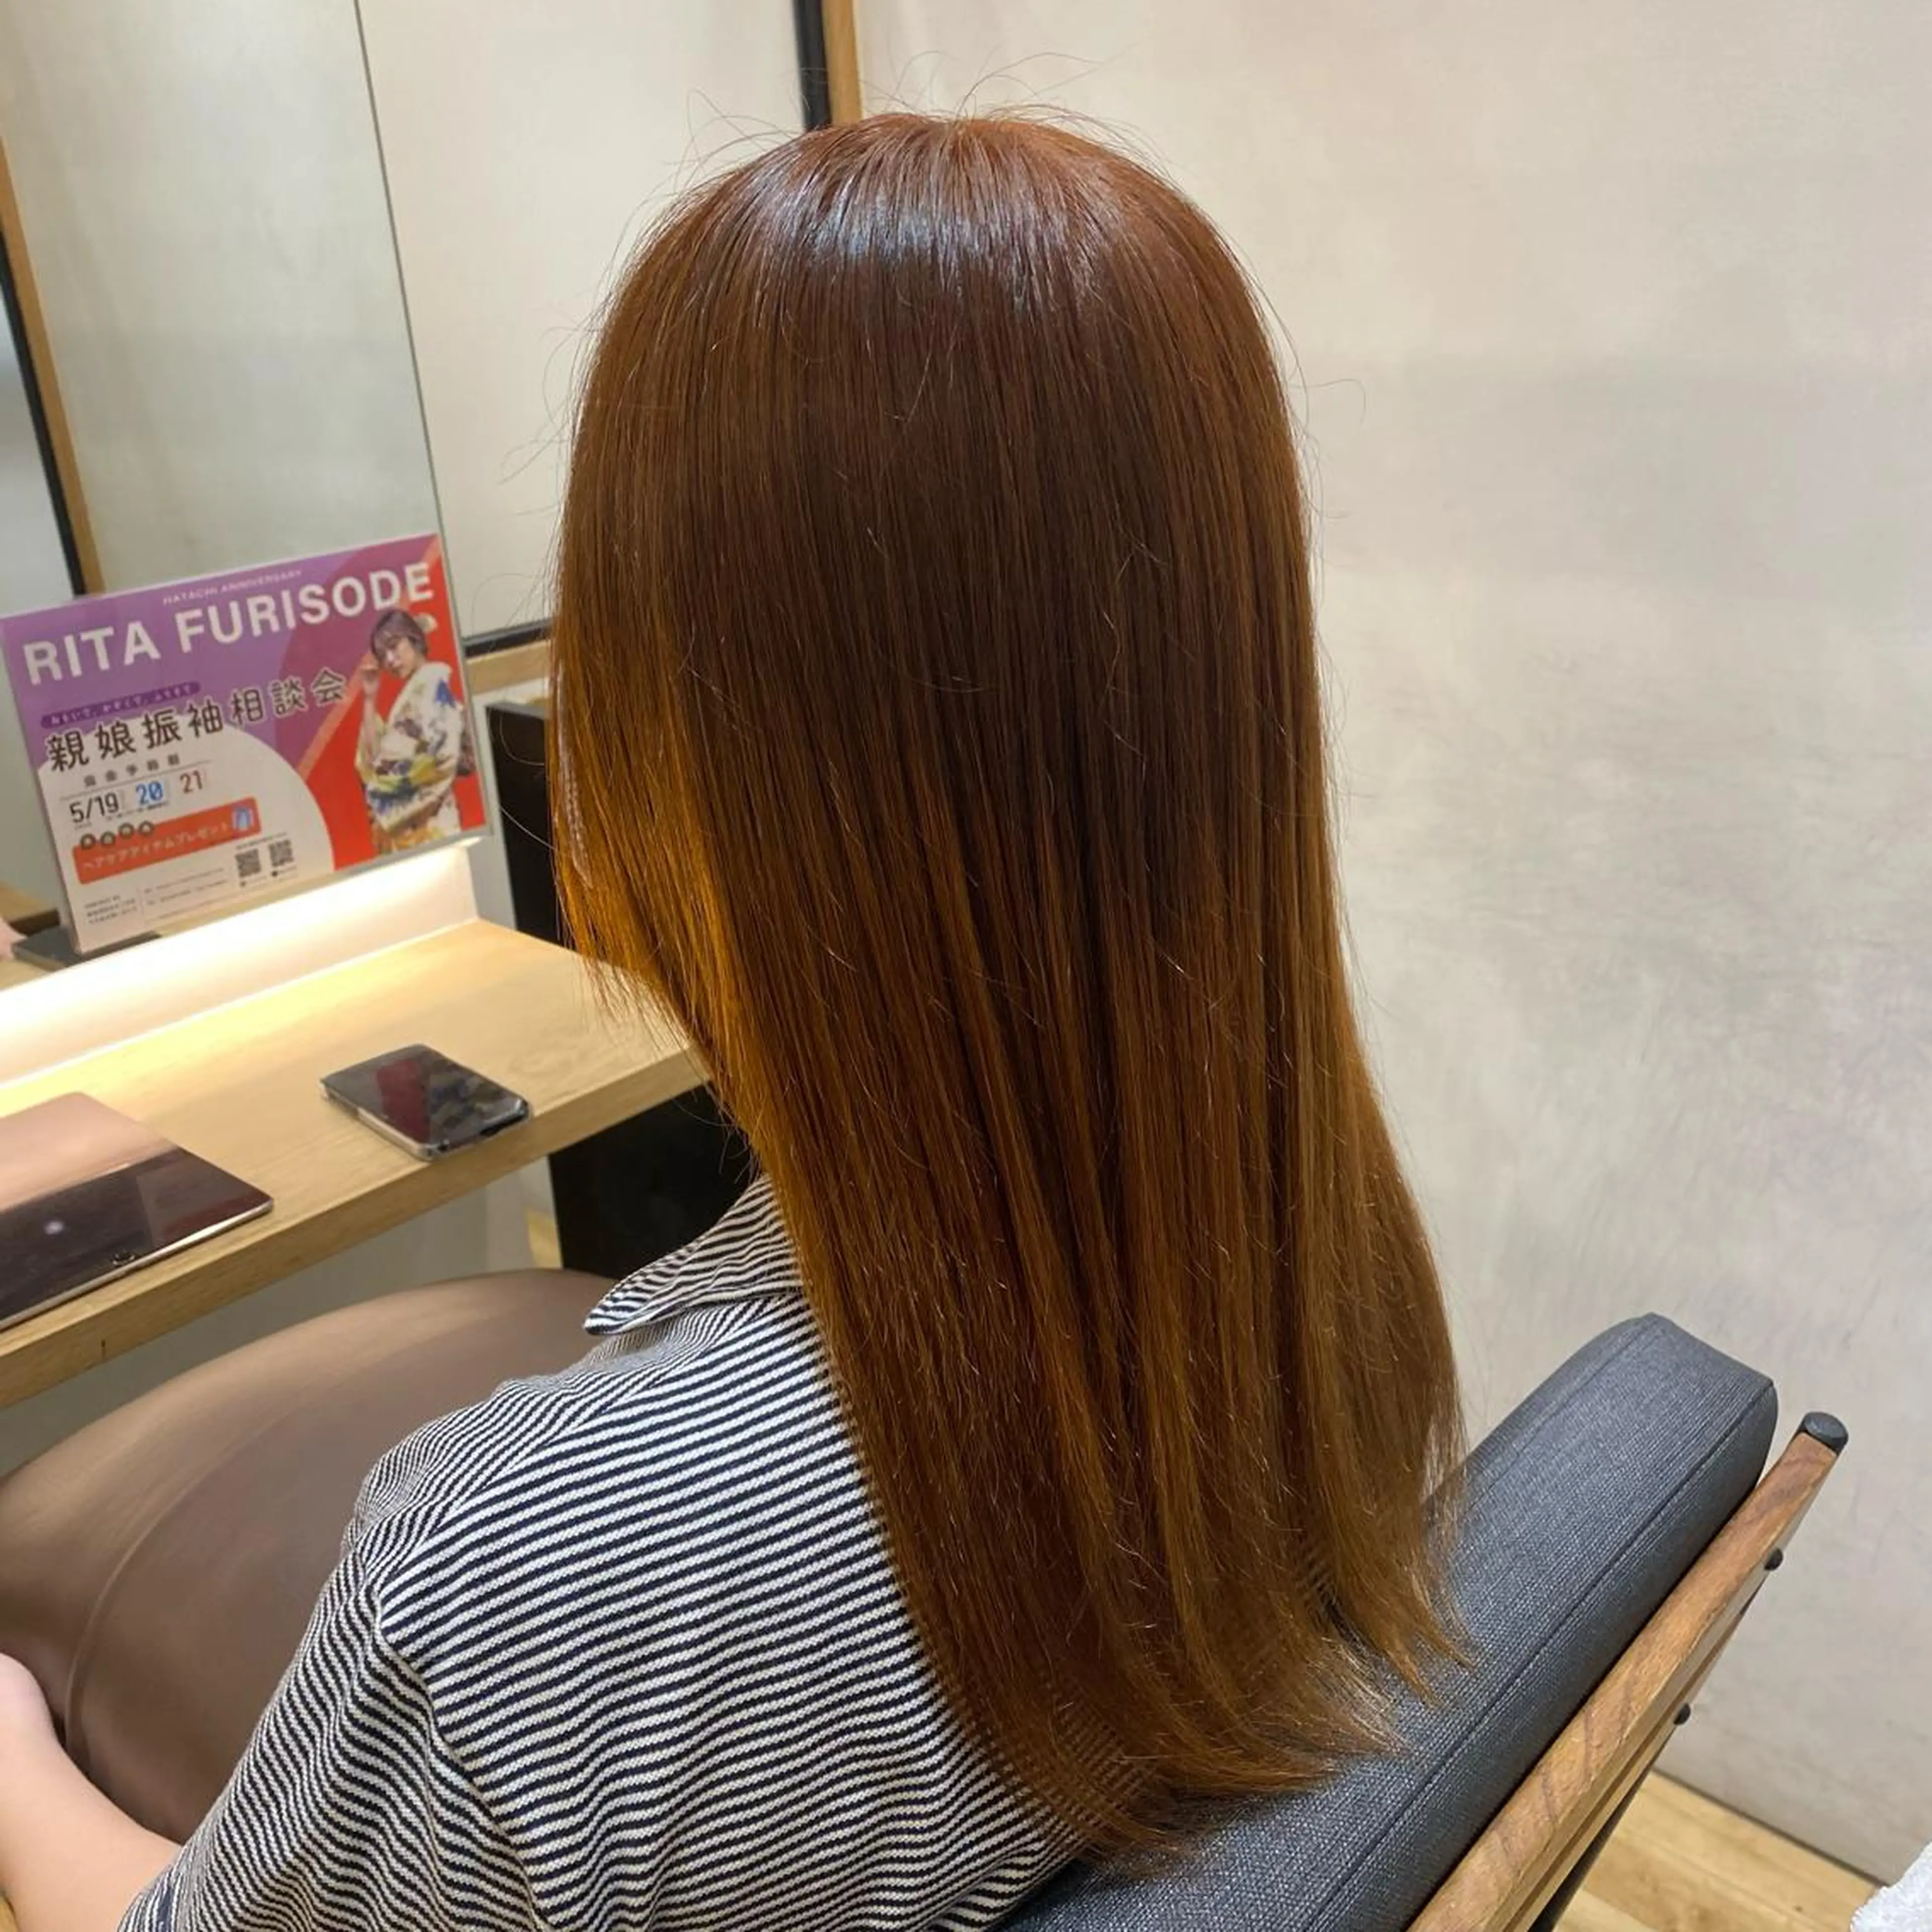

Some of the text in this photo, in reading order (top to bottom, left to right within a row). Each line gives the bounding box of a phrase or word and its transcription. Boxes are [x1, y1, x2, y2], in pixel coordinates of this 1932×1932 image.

[23, 562, 434, 685] RITA FURISODE
[46, 668, 345, 772] 親娘振袖相談会
[69, 792, 119, 824] 5/19
[135, 780, 164, 805] 20
[179, 770, 203, 794] 21
